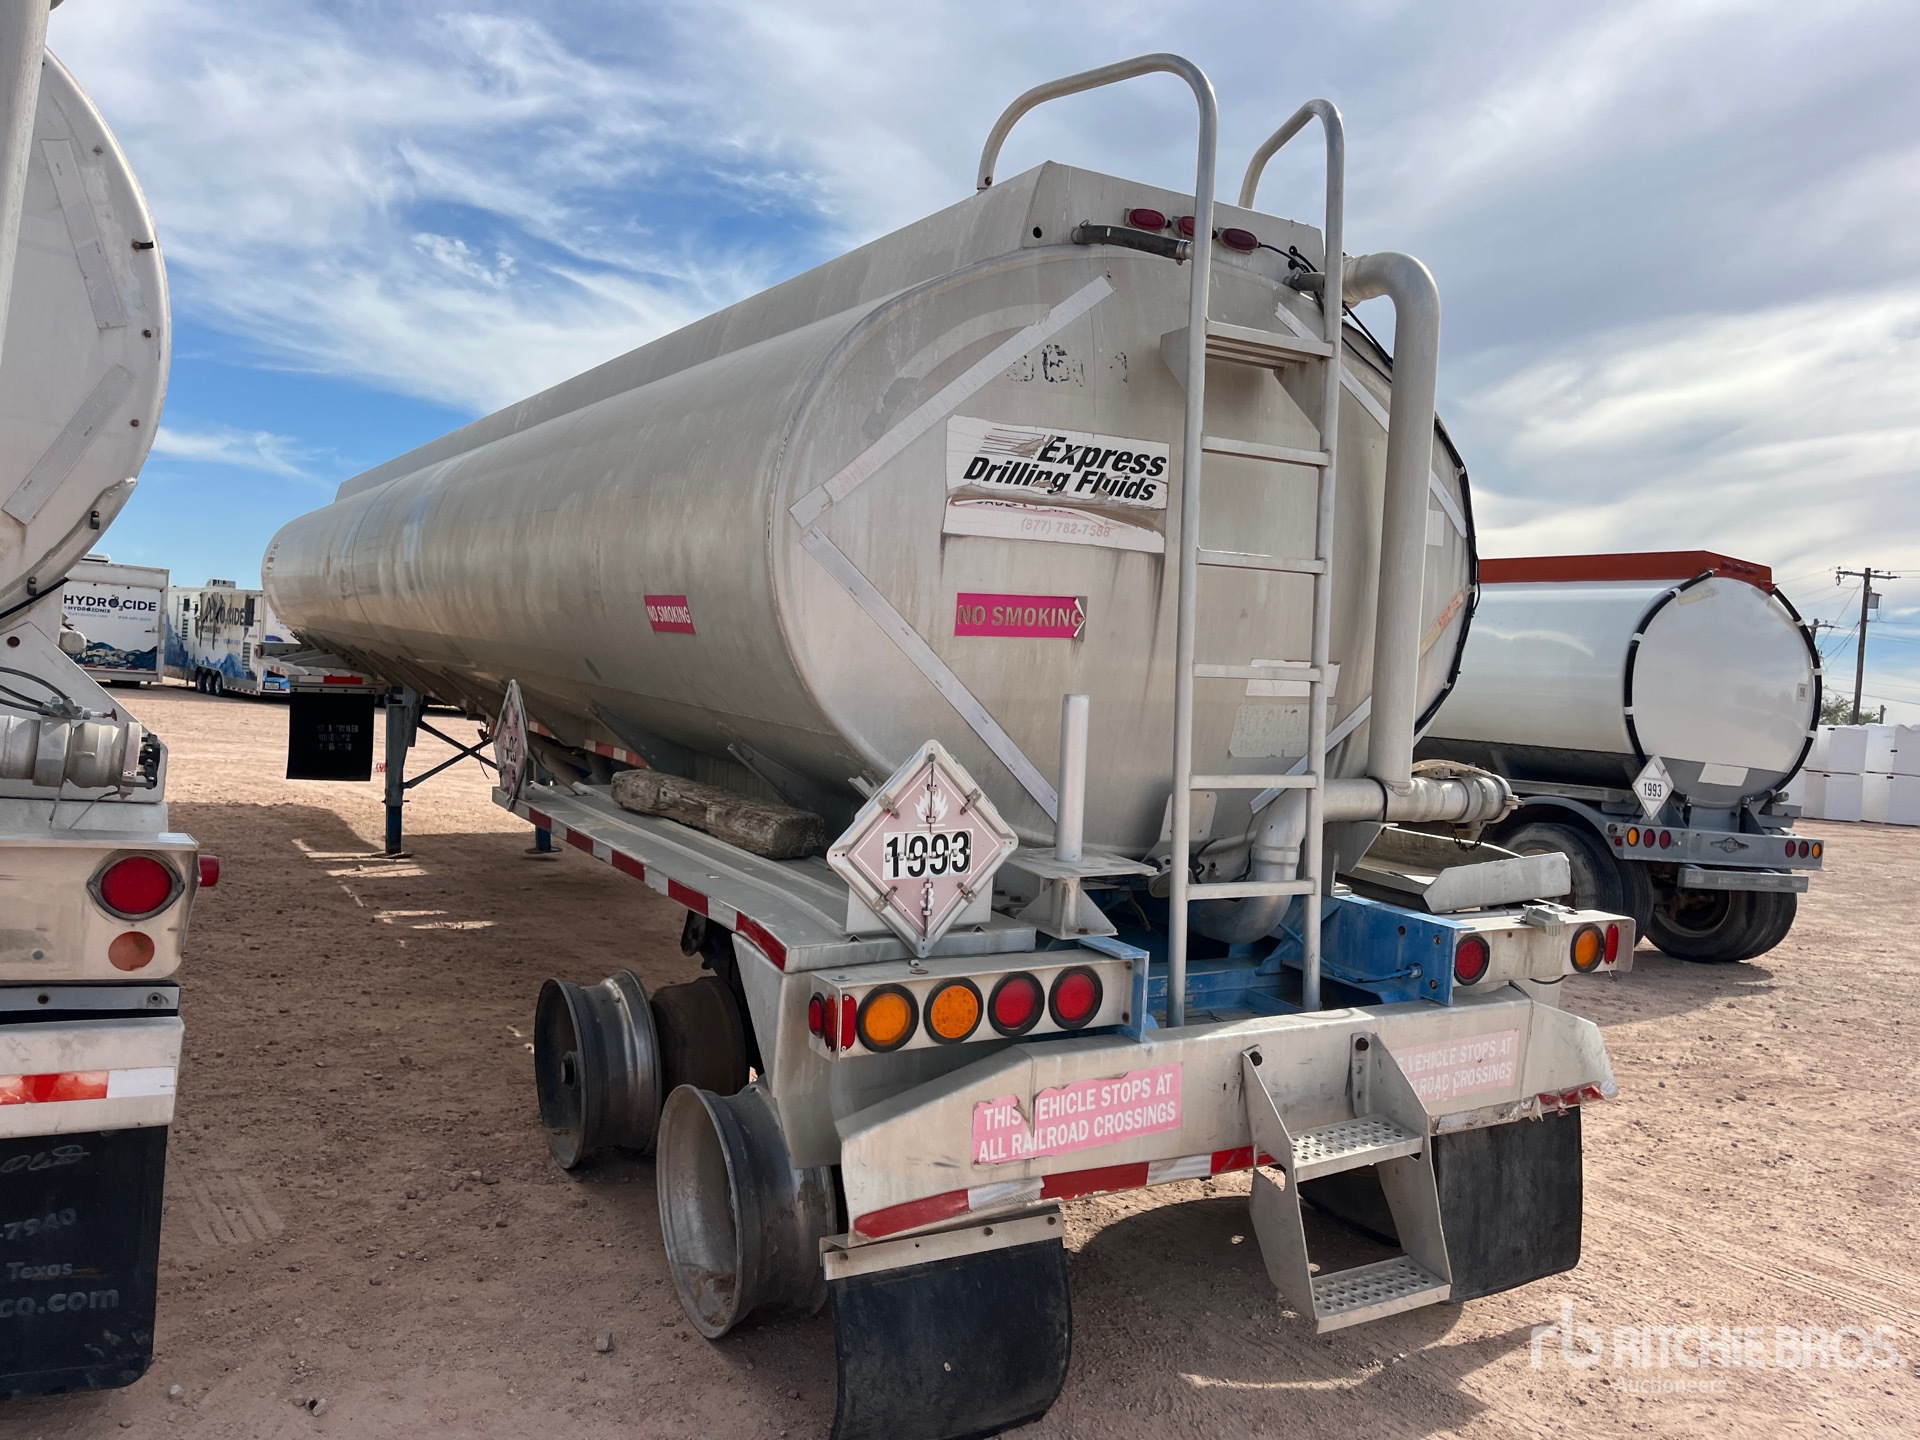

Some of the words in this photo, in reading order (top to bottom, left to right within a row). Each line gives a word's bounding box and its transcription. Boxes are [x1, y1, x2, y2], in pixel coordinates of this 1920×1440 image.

[1037, 436, 1167, 477] Express
[963, 456, 1071, 494] Drilling
[1074, 470, 1157, 501] Fluids
[1021, 518, 1050, 534] (877)
[646, 605, 659, 622] NO
[656, 605, 692, 624] SMOKING
[957, 604, 987, 626] NO
[991, 606, 1084, 628] SMOKING
[1643, 782, 1662, 798] 1993
[886, 831, 971, 879] 1993
[1408, 1047, 1457, 1073] VEHICLE
[1460, 1040, 1496, 1063] STOPS
[1500, 1037, 1513, 1056] AT
[1452, 1061, 1512, 1090] CROSSINGS
[984, 1105, 1021, 1131] THIS
[1100, 1077, 1151, 1107] STOPS
[1155, 1073, 1173, 1096] AT
[978, 1137, 1006, 1162] ALL
[1011, 1118, 1089, 1156] RAILROAD
[1093, 1101, 1176, 1137] CROSSINGS
[6, 1261, 73, 1280] Texas
